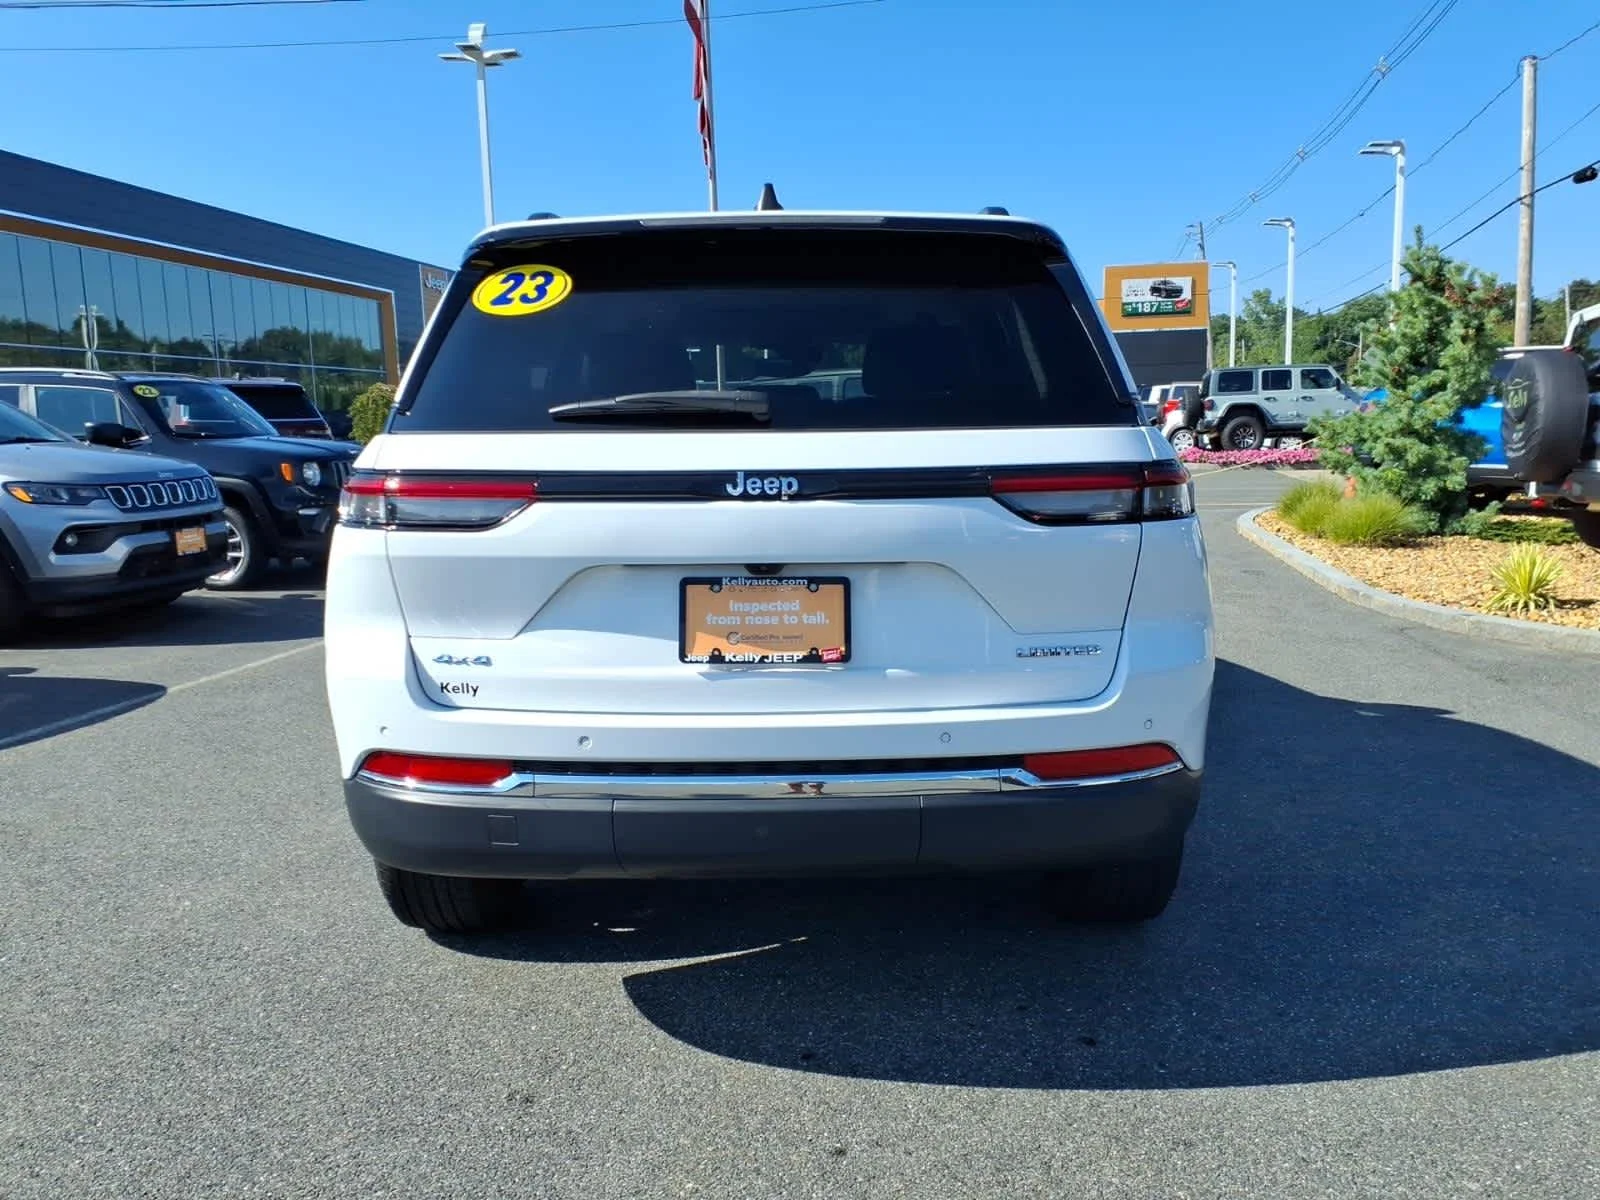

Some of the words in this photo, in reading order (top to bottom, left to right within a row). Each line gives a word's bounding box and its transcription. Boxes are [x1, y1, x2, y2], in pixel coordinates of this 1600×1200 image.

[490, 270, 554, 306] 23
[725, 470, 799, 501] Jeep
[722, 577, 808, 586] Kellyauto.com
[729, 600, 801, 613] Inspected
[706, 614, 741, 625] from
[745, 615, 779, 625] nose
[783, 613, 798, 625] to
[684, 653, 710, 663] Jeep
[725, 650, 761, 663] Kelly
[764, 653, 803, 663] JEEP
[440, 681, 480, 697] Kelly
